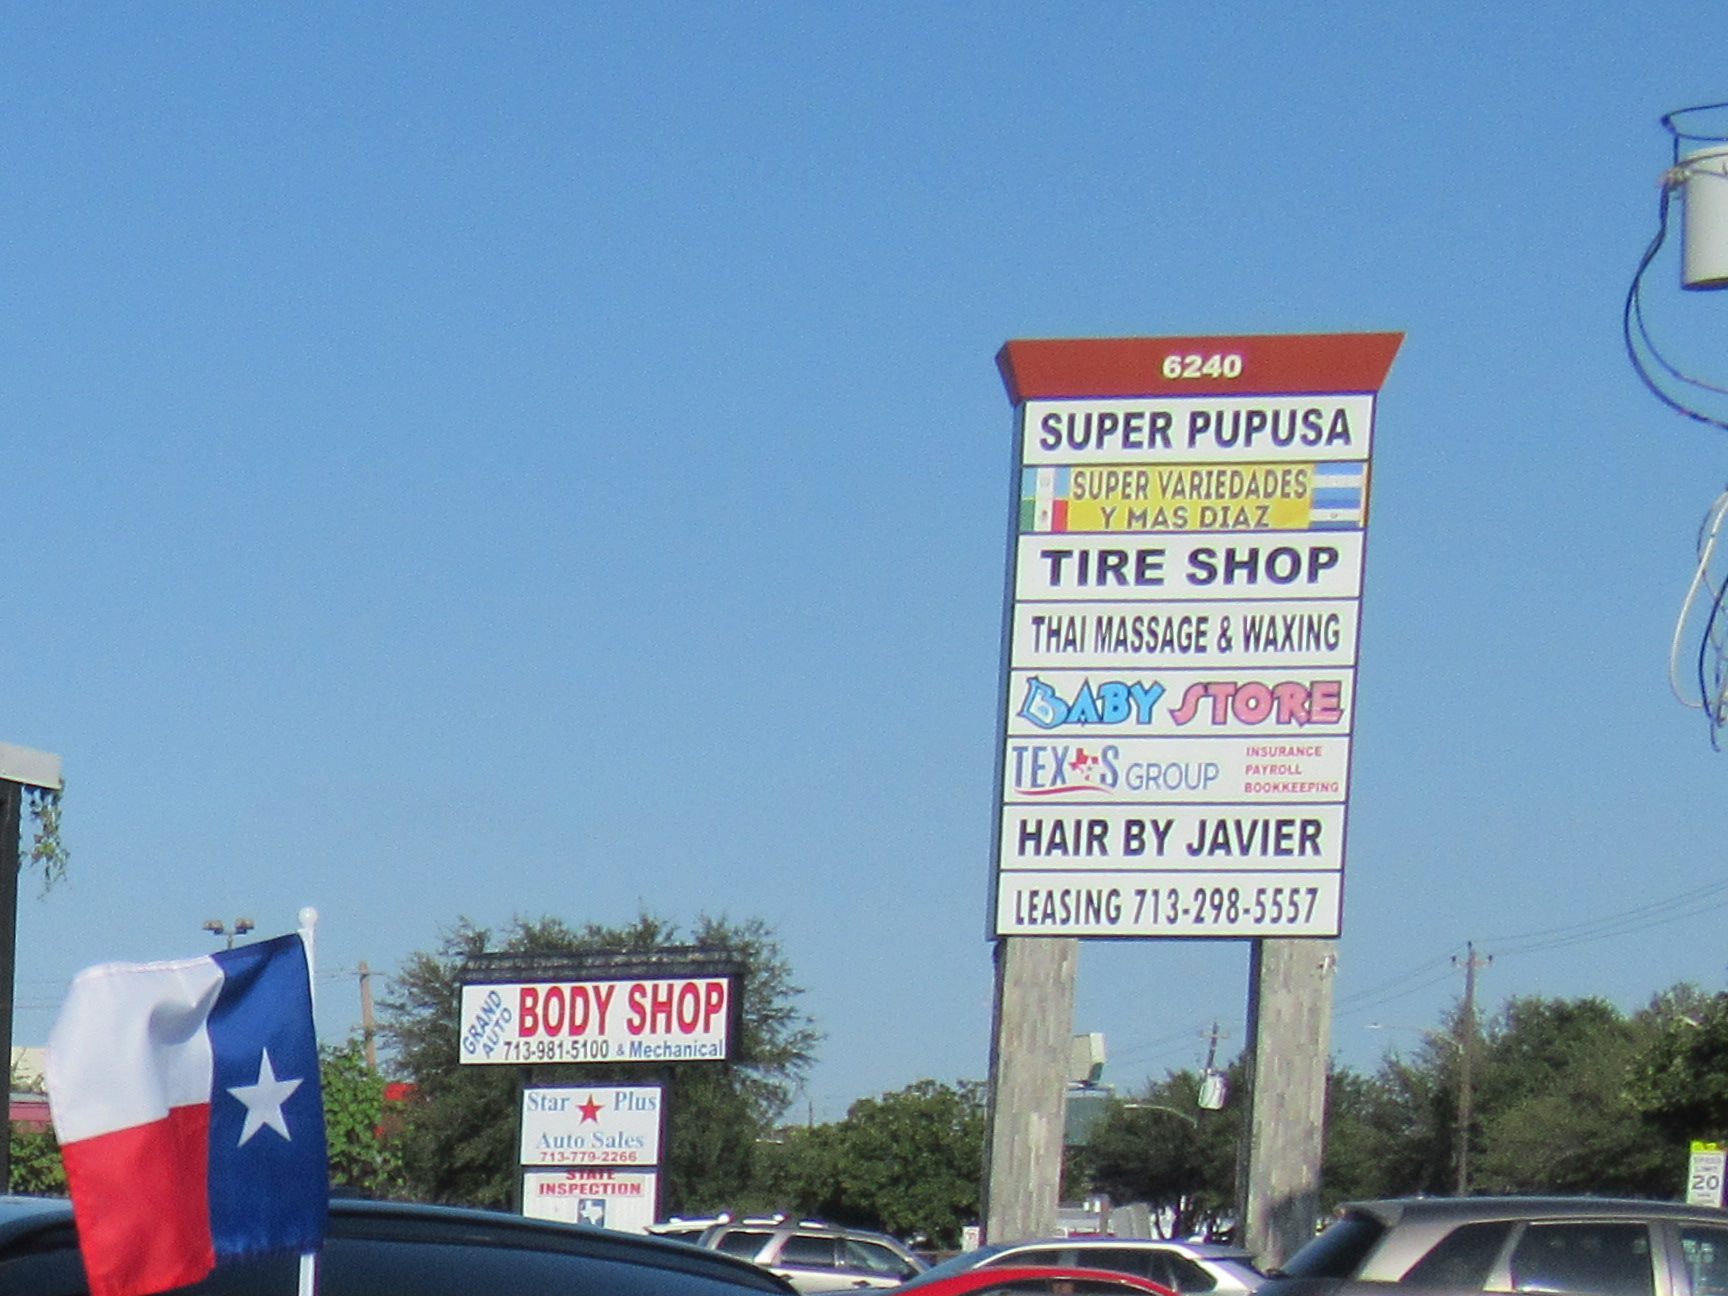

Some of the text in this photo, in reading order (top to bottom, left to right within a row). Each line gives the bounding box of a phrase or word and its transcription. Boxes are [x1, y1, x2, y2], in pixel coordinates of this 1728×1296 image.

[1161, 354, 1243, 379] 6240
[1039, 408, 1352, 450] SUPER PUPUSA
[1072, 468, 1308, 500] SUPER VARIEDADES
[1099, 505, 1271, 529] Y MAS DIAZ
[1039, 546, 1340, 586] TIRE SHOP
[1031, 613, 1341, 653] THAI MASSAGE & WAXING
[1016, 675, 1344, 729] BABY STORE
[1246, 746, 1323, 758] INSURANCE
[1125, 762, 1220, 790] GROUP
[1245, 764, 1302, 776] PAYROLL
[1244, 782, 1339, 793] BOOKKEEPING
[1017, 818, 1323, 857] HAIR BY JAVIER
[1014, 886, 1319, 926] LEASING 713-298-5557
[462, 990, 502, 1055] GRAND
[518, 982, 725, 1038] BODY SHOP
[481, 1007, 513, 1059] AUTO
[503, 1039, 609, 1061] 713-981-5100
[629, 1039, 724, 1059] Mechanical
[527, 1091, 656, 1111] Star Plus
[536, 1131, 644, 1149] Auto Sales
[539, 1183, 641, 1195] INSPECTION
[1692, 1175, 1719, 1190] 20
